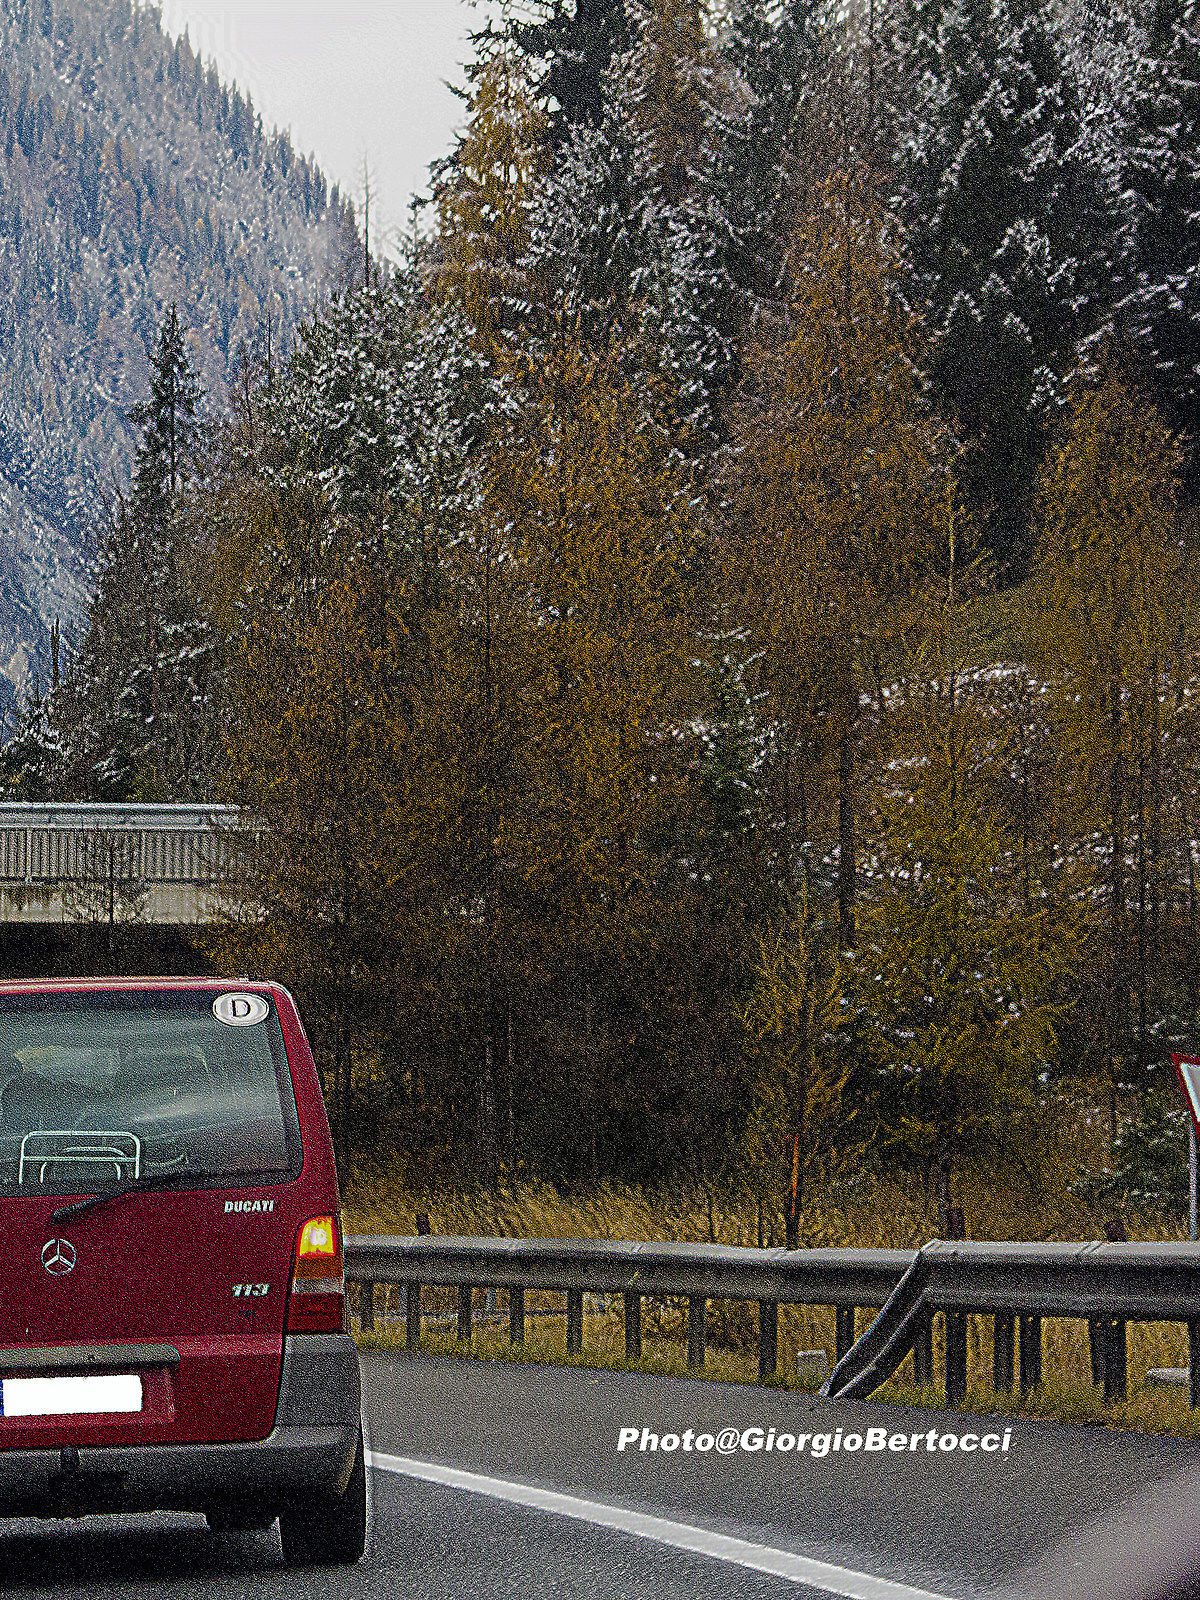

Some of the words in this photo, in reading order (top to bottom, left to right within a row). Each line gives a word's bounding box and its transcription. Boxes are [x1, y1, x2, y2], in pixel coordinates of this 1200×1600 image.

[231, 999, 251, 1018] D
[223, 1199, 275, 1214] DUCATI
[231, 1282, 271, 1298] 113
